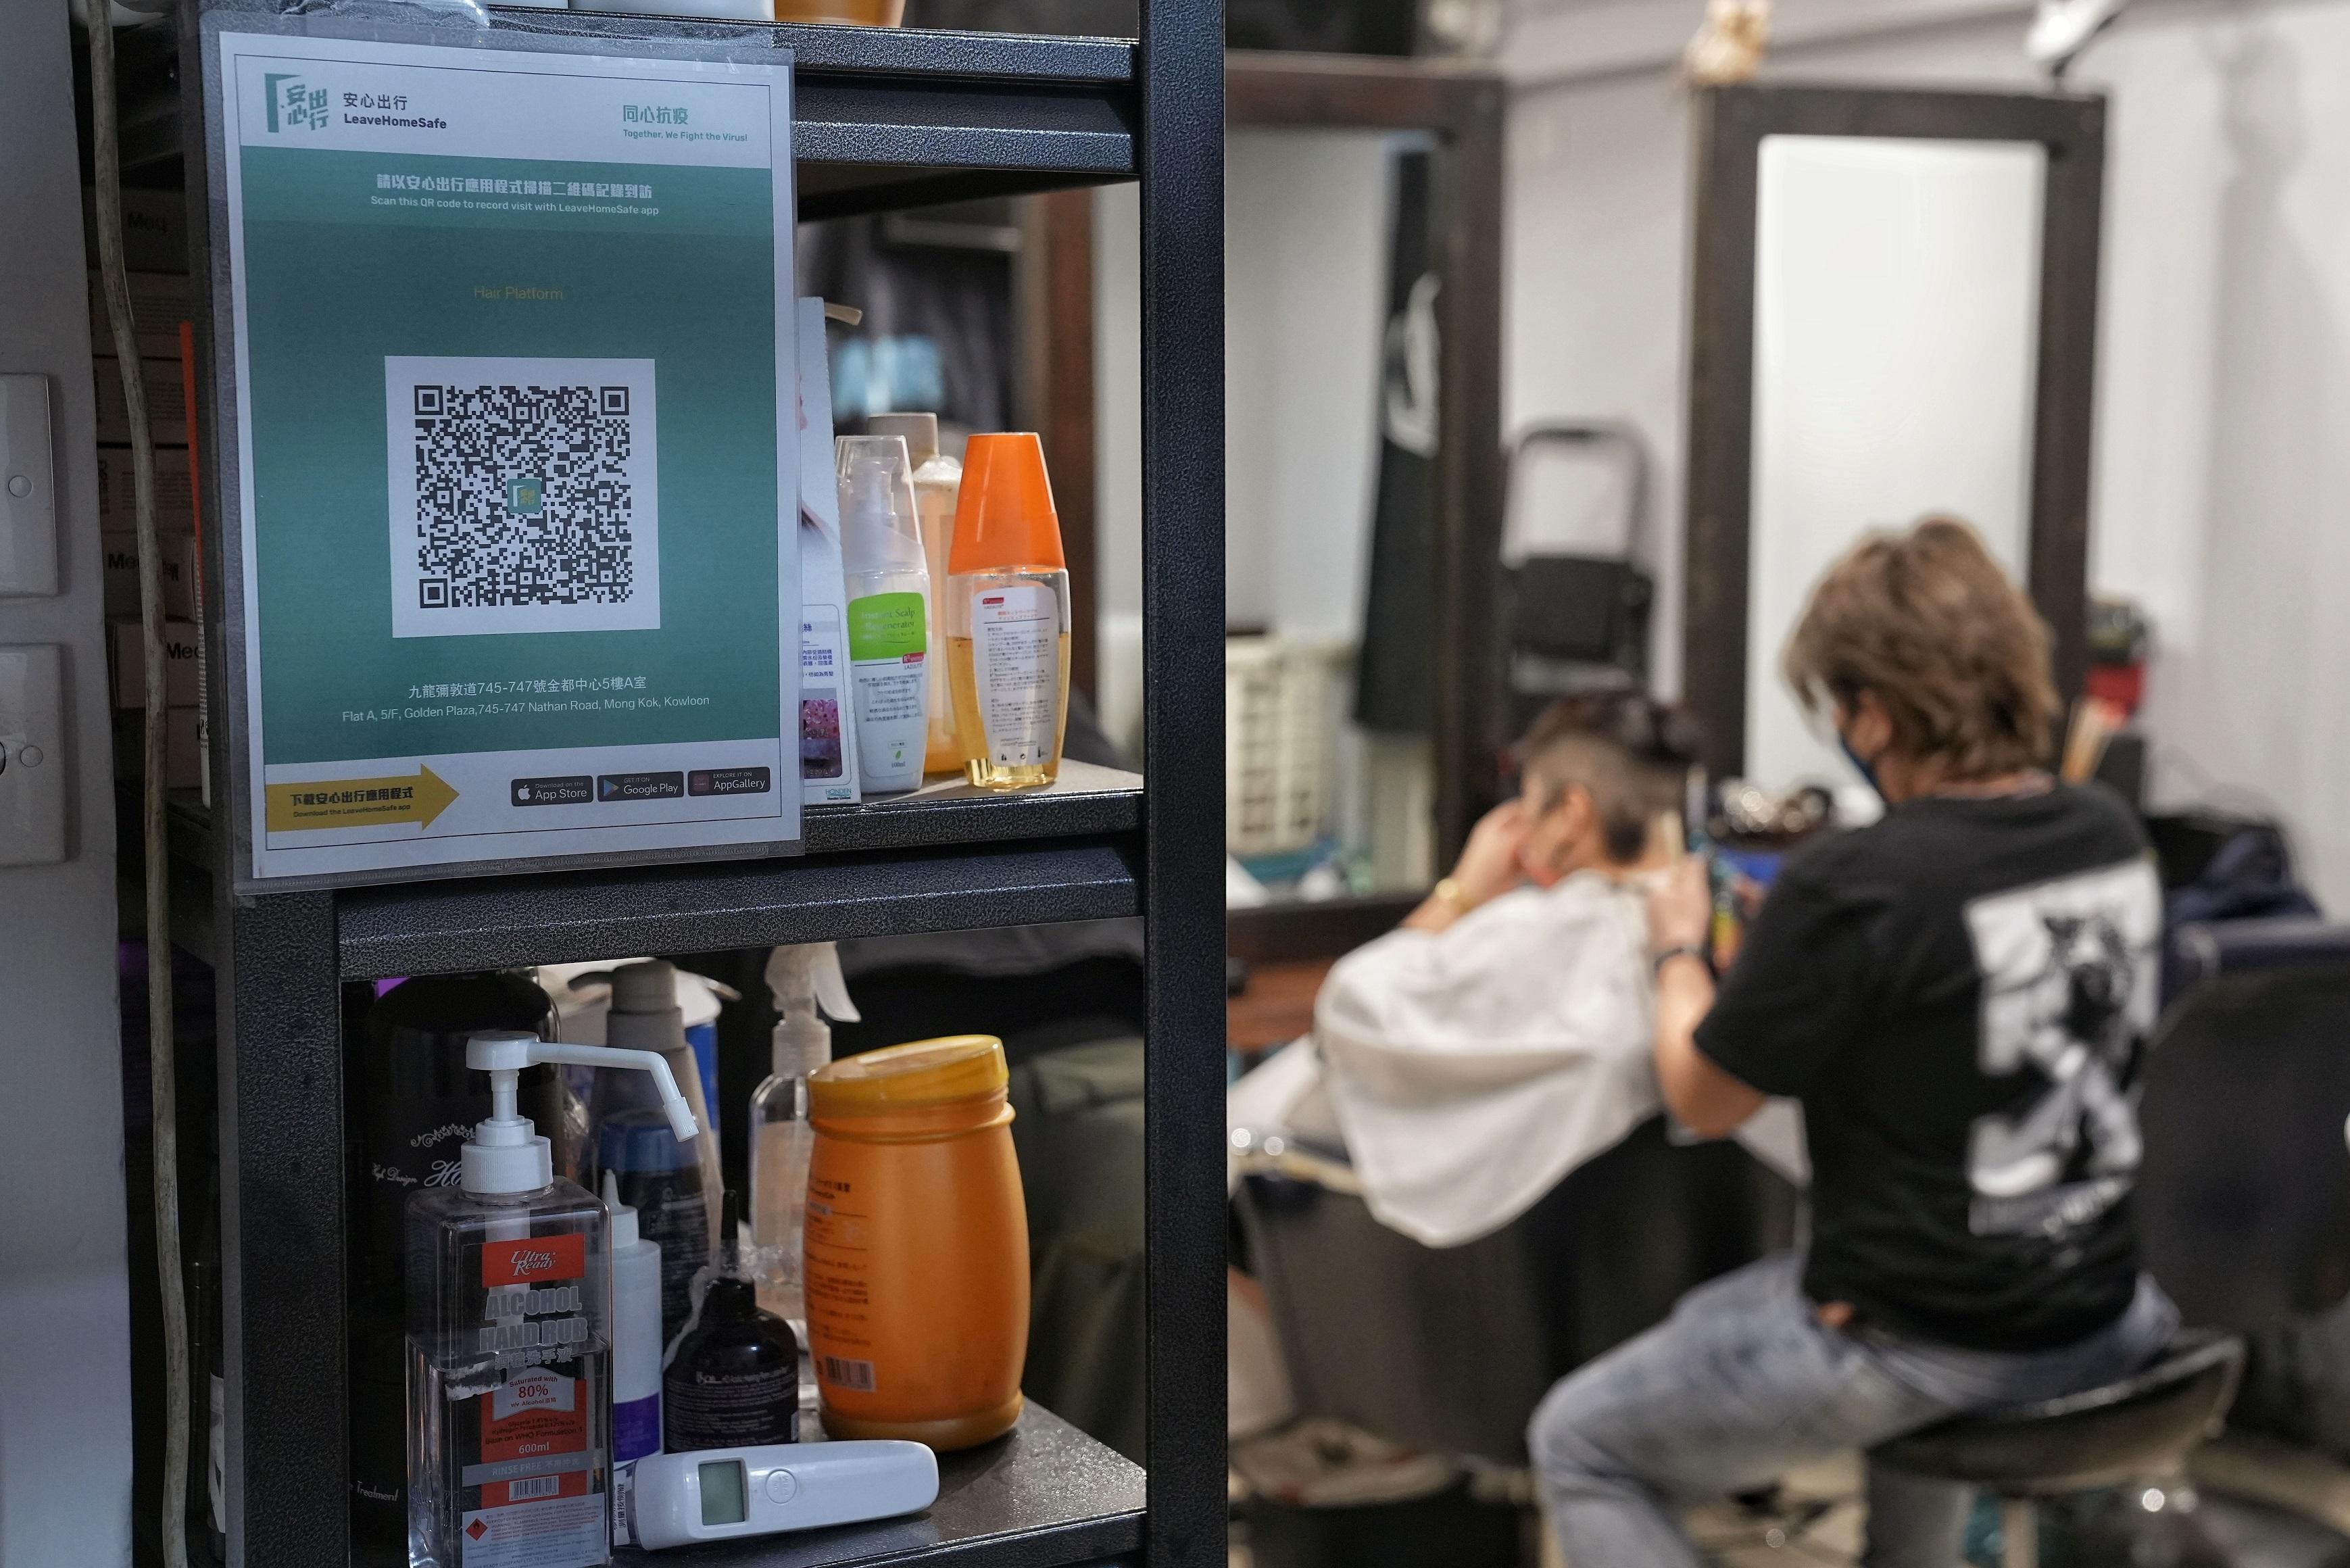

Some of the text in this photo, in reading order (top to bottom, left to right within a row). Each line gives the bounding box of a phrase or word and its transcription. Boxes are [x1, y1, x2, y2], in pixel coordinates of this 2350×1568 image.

[343, 92, 408, 111] 安心出行
[344, 113, 447, 128] LeaveHomeSafe
[623, 105, 689, 125] 同心抗疫
[681, 131, 704, 141] Fight
[723, 133, 748, 141] Virus!
[371, 195, 659, 216] Scan this QR code to record visit with LeaveHomeSafe app
[474, 286, 563, 300] Hair Platform
[896, 607, 915, 618] Scalp
[408, 676, 647, 699] 九龍彌敦道745-747號金都中心5樓A室
[343, 710, 364, 722] Flat
[366, 710, 378, 722] A,
[381, 709, 401, 720] 5/F,
[404, 707, 443, 718] Golden
[529, 701, 567, 712] Nathan
[570, 700, 601, 711] Road,
[604, 698, 635, 710] Mong
[638, 697, 661, 708] Kok,
[664, 696, 710, 707] Kowloon
[623, 783, 678, 795] Google Play
[714, 779, 766, 791] AppGallery
[825, 788, 852, 796] HONDEN
[290, 786, 414, 806] 下載安心出行應用程式
[535, 788, 587, 802] App Store
[510, 1249, 551, 1264] Ultra
[512, 1258, 556, 1277] Ready
[485, 1286, 583, 1321] ALCOHOL
[479, 1317, 588, 1352] HAND RUB
[494, 1346, 572, 1371] 酒精洗手液
[509, 1376, 542, 1388] Saturated
[518, 1383, 549, 1398] 80%
[515, 1431, 534, 1440] WHO
[518, 1442, 549, 1454] 600ml
[492, 1464, 519, 1476] RINSE
[520, 1461, 541, 1472] FREE
[357, 1480, 399, 1502] Treatment
